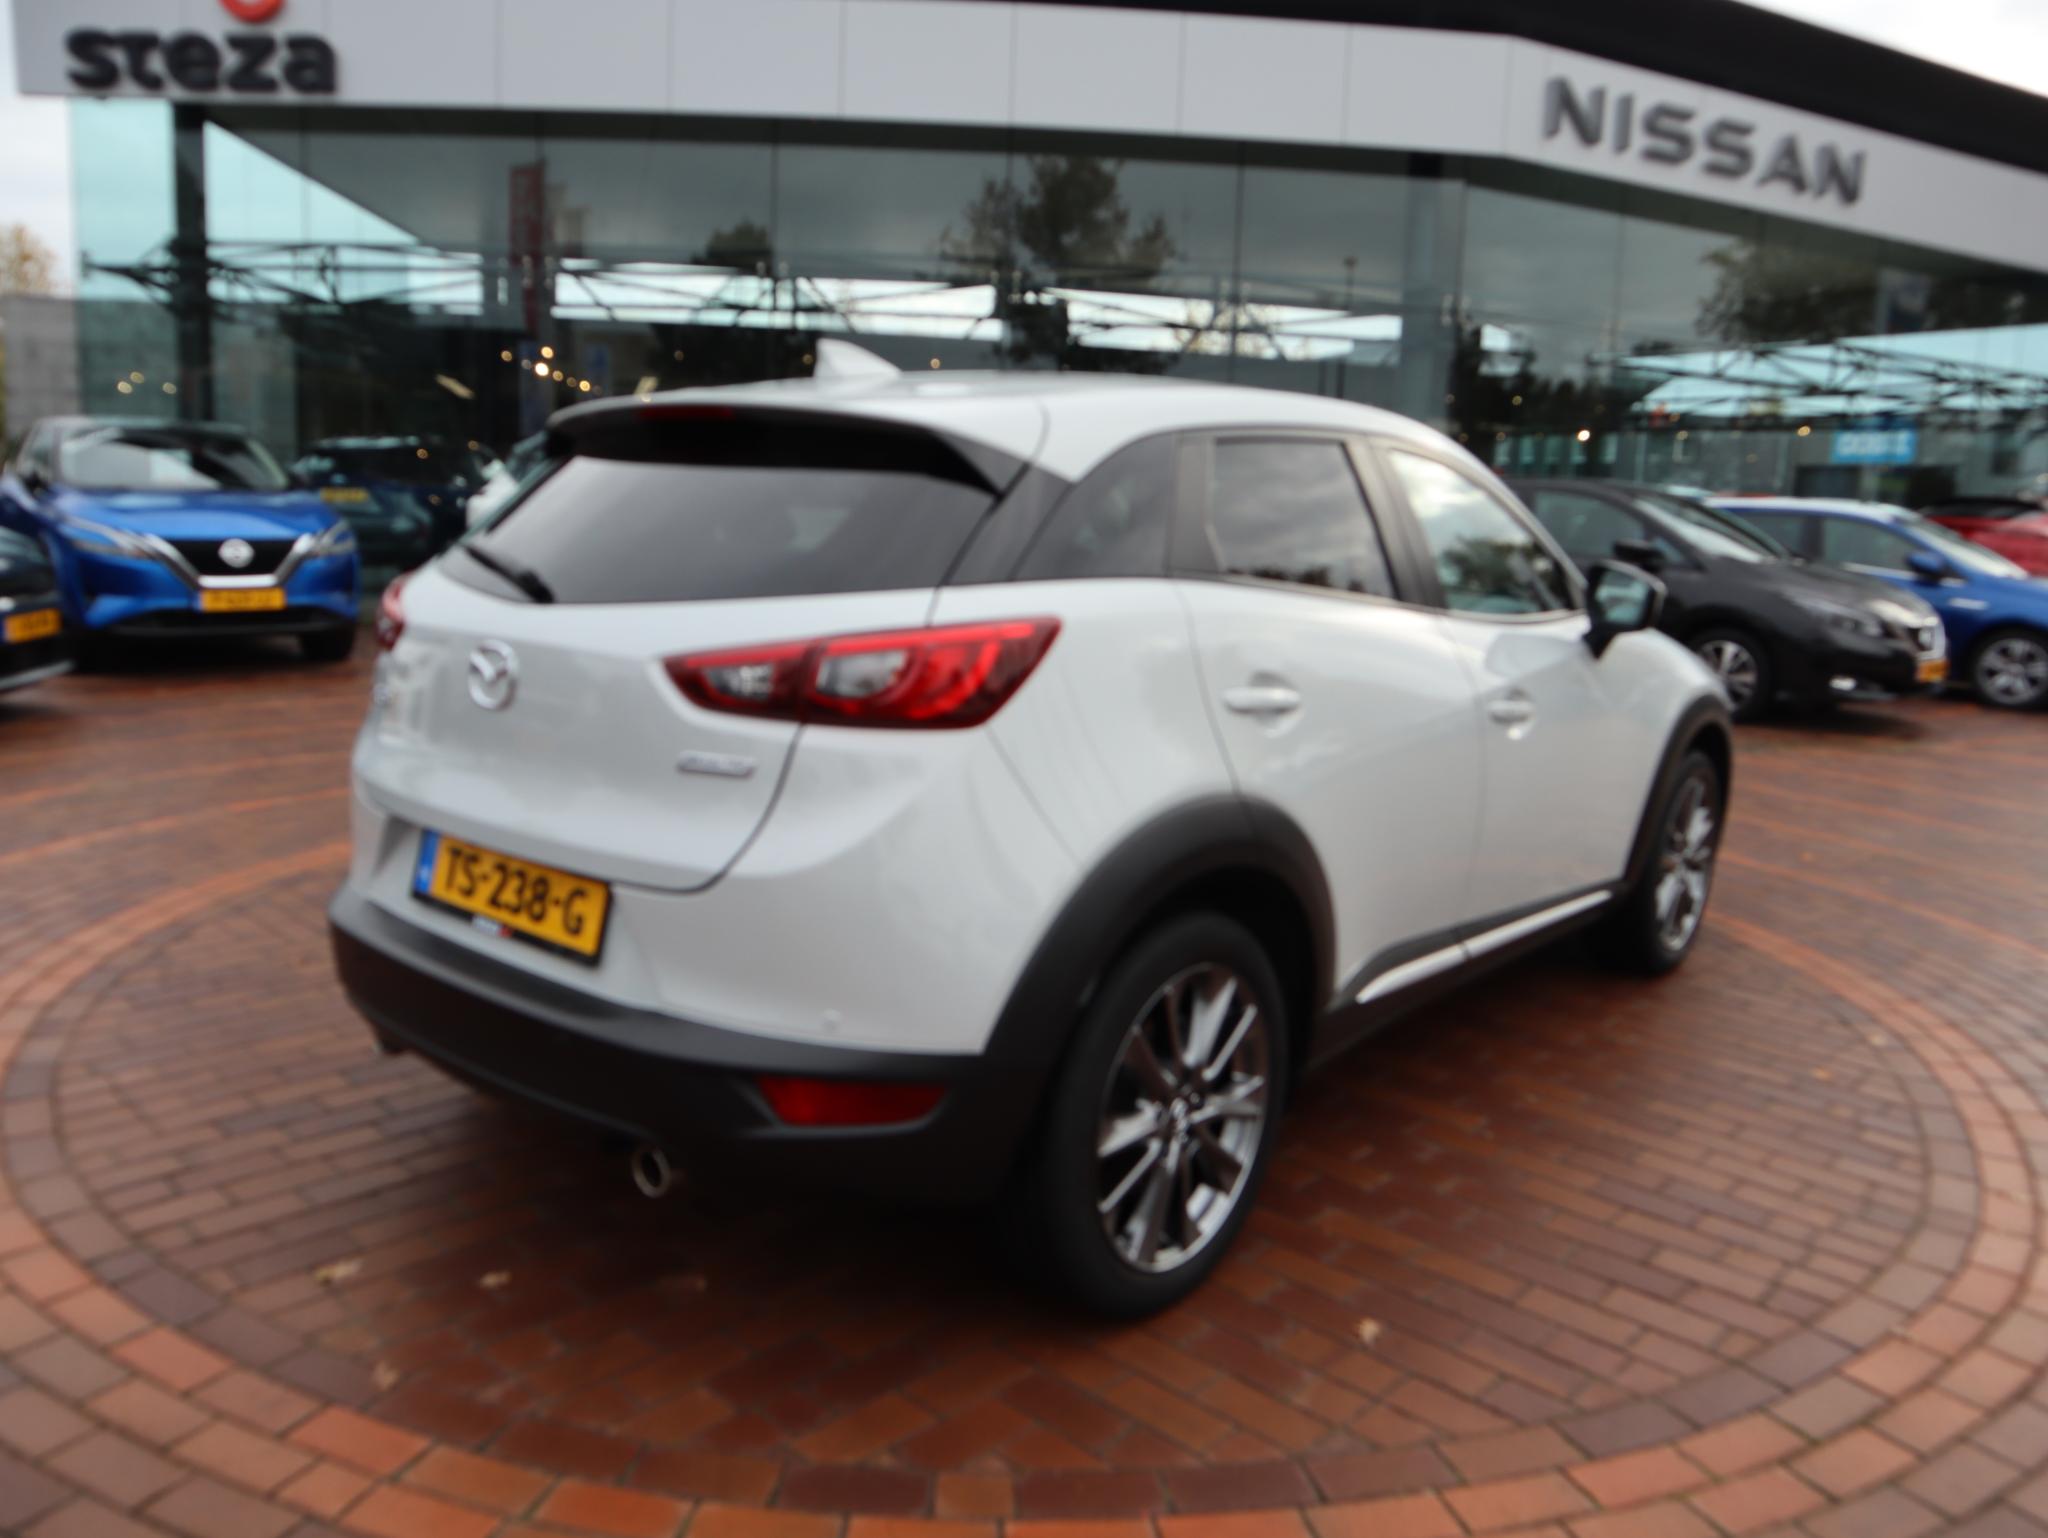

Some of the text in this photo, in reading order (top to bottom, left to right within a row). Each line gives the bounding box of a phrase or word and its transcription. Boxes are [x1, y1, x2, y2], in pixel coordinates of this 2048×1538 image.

[66, 30, 337, 94] steza
[1544, 77, 1865, 205] NISSAN
[446, 847, 587, 936] TS-238-G
